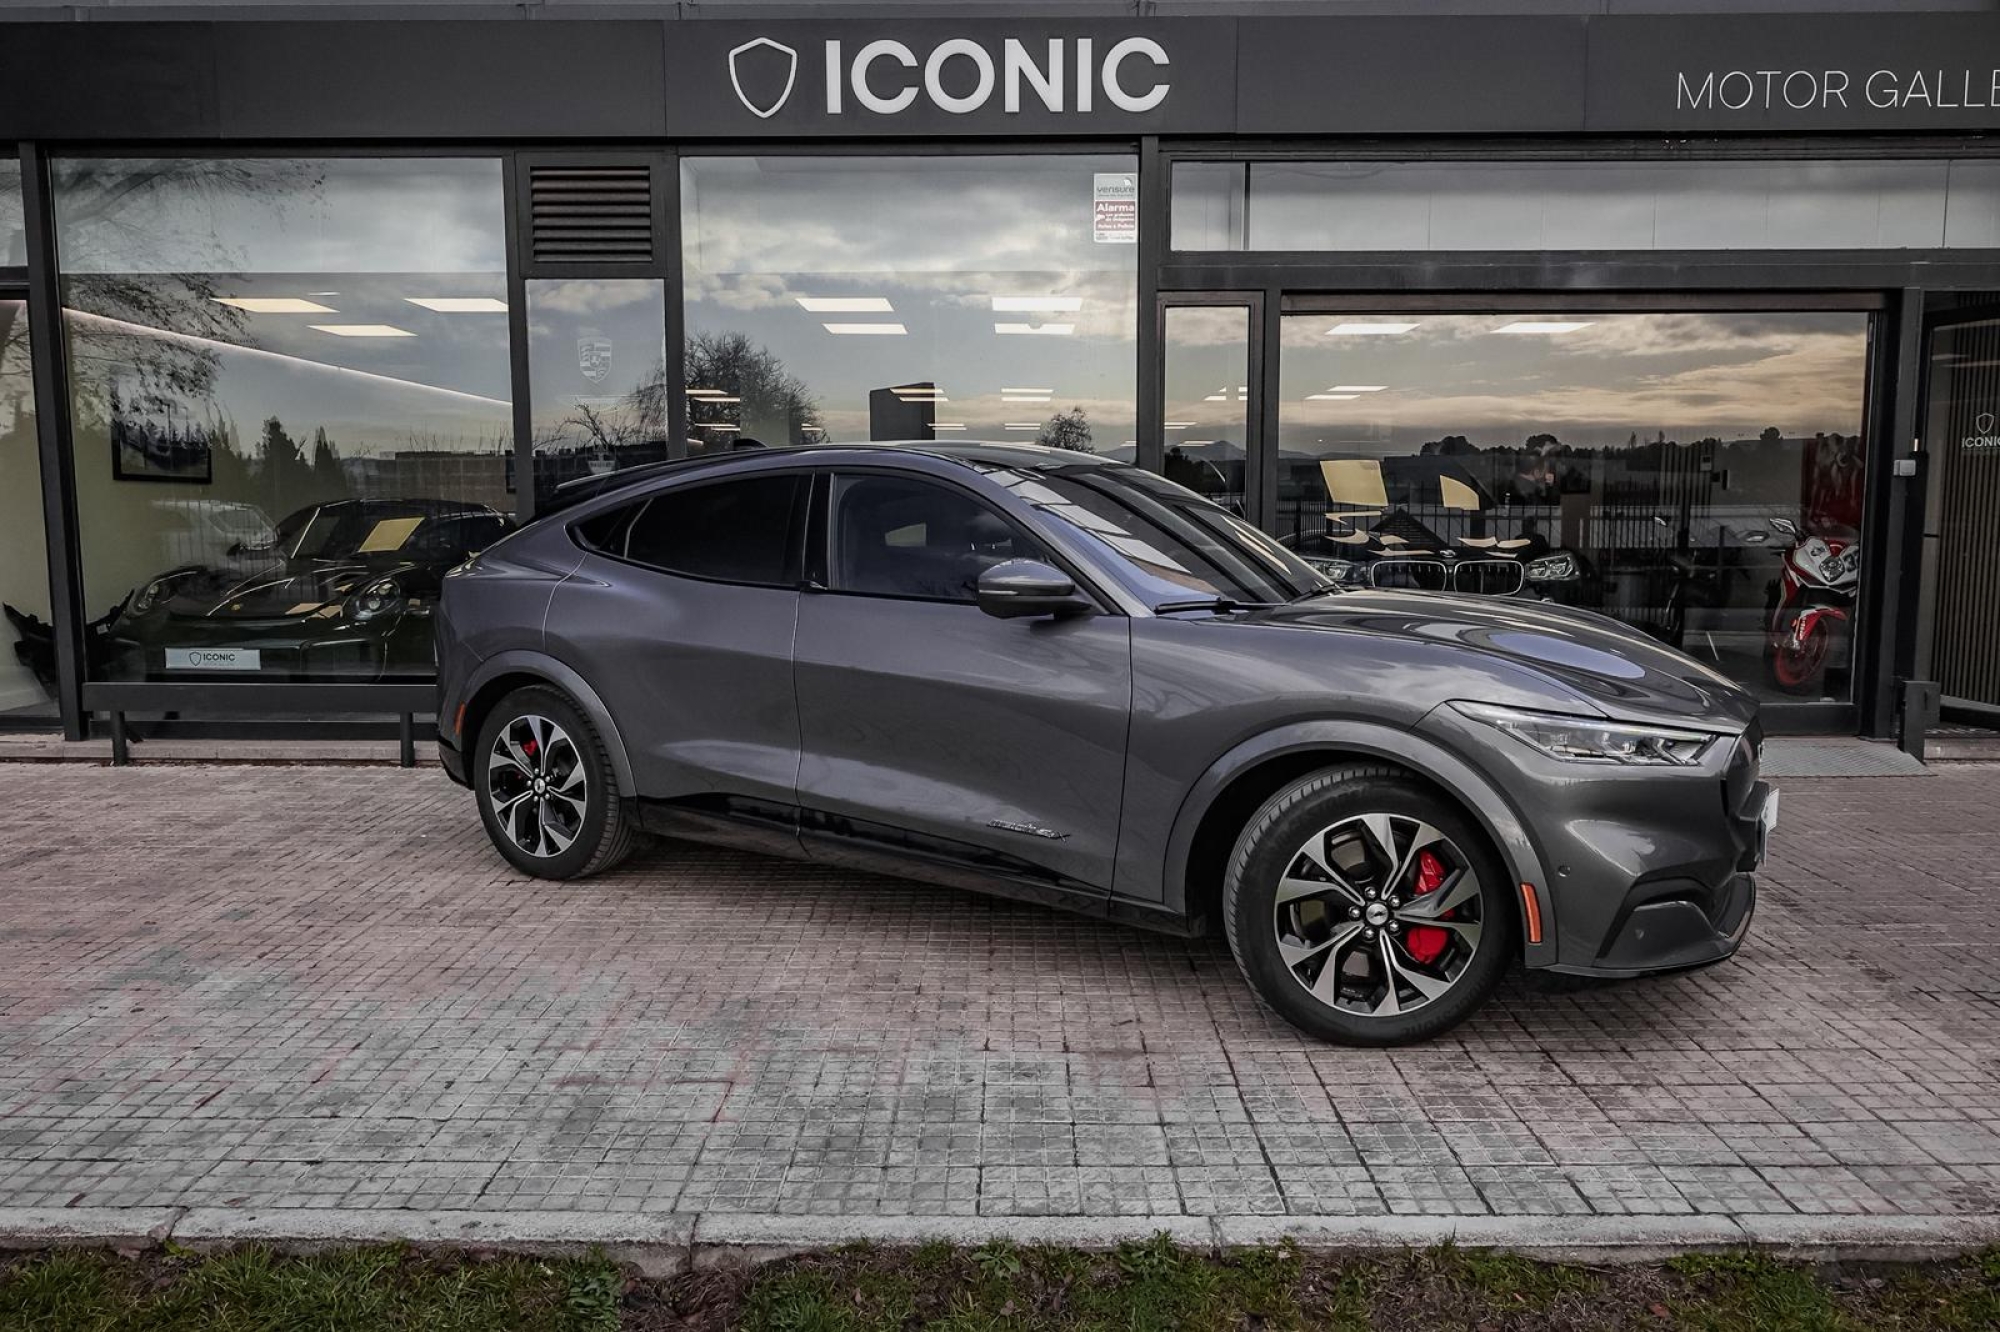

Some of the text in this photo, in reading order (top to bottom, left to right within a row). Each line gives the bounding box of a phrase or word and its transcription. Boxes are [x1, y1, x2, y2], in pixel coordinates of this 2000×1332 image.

[825, 36, 1170, 115] ICONIC
[1676, 70, 1850, 110] MOTOR
[1096, 203, 1135, 212] Alarma
[203, 653, 236, 662] ICONIC
